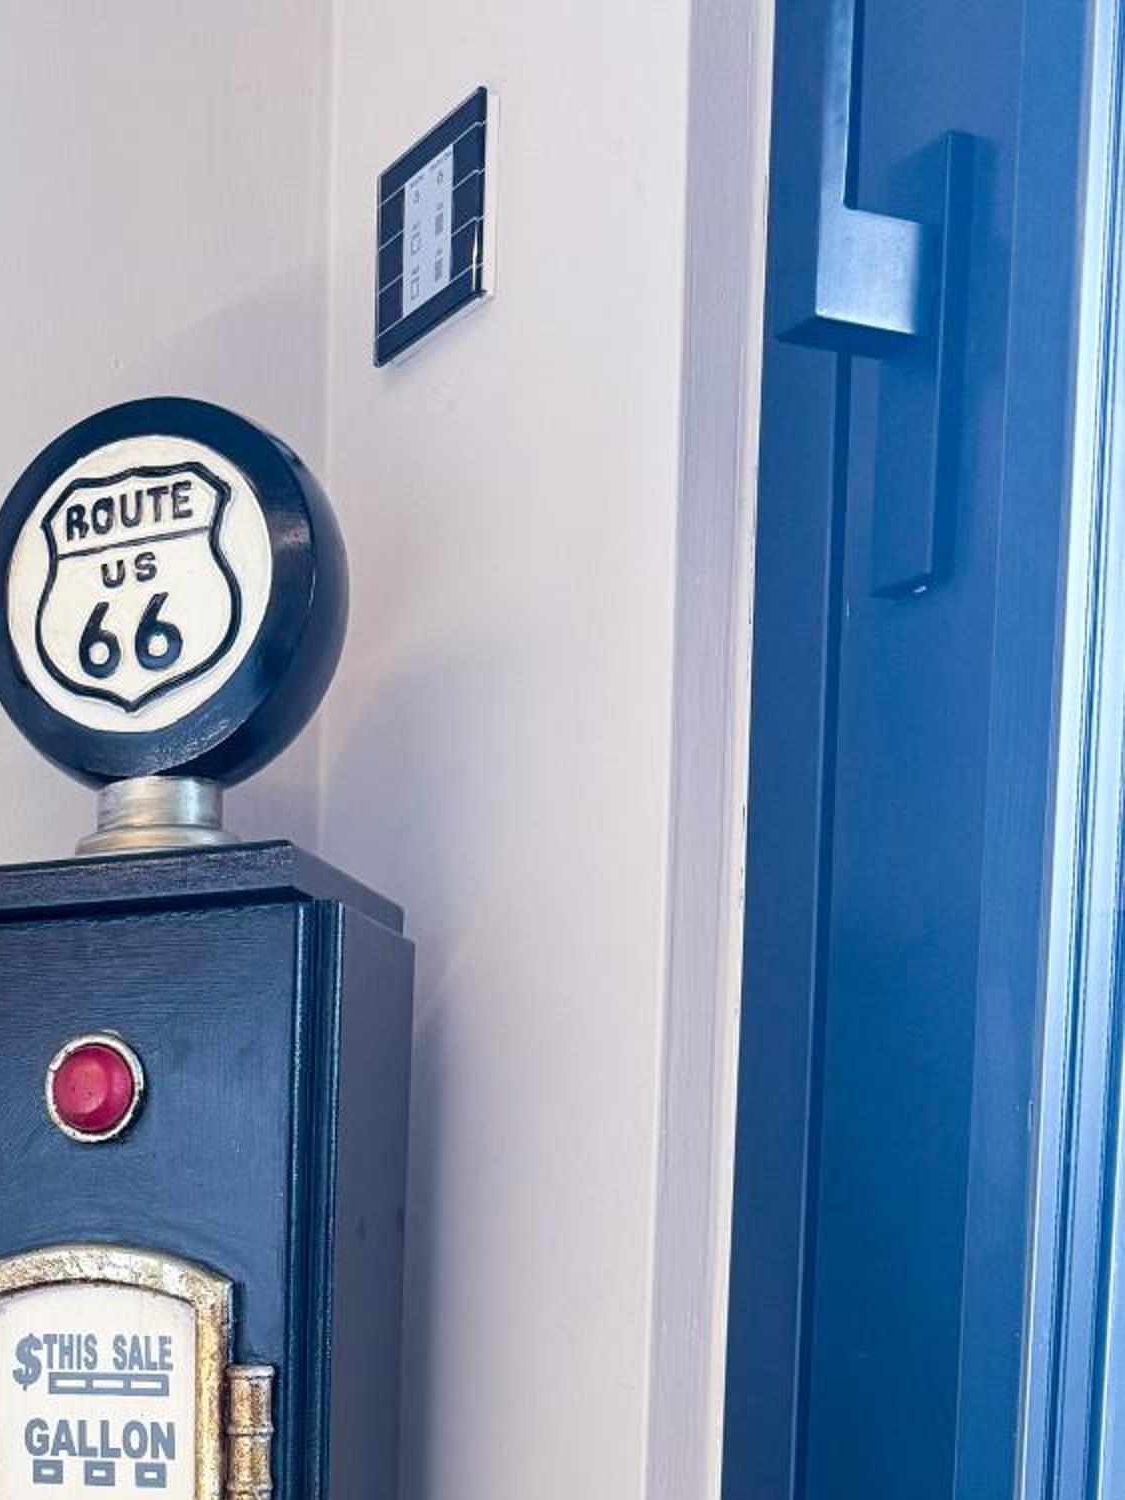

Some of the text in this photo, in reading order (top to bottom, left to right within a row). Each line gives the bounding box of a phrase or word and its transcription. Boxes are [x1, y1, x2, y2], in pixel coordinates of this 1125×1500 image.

[66, 481, 193, 541] ROUTE
[101, 552, 157, 588] US
[78, 592, 183, 679] 66
[112, 1334, 173, 1371] SALE
[24, 1418, 175, 1460] GALLON
